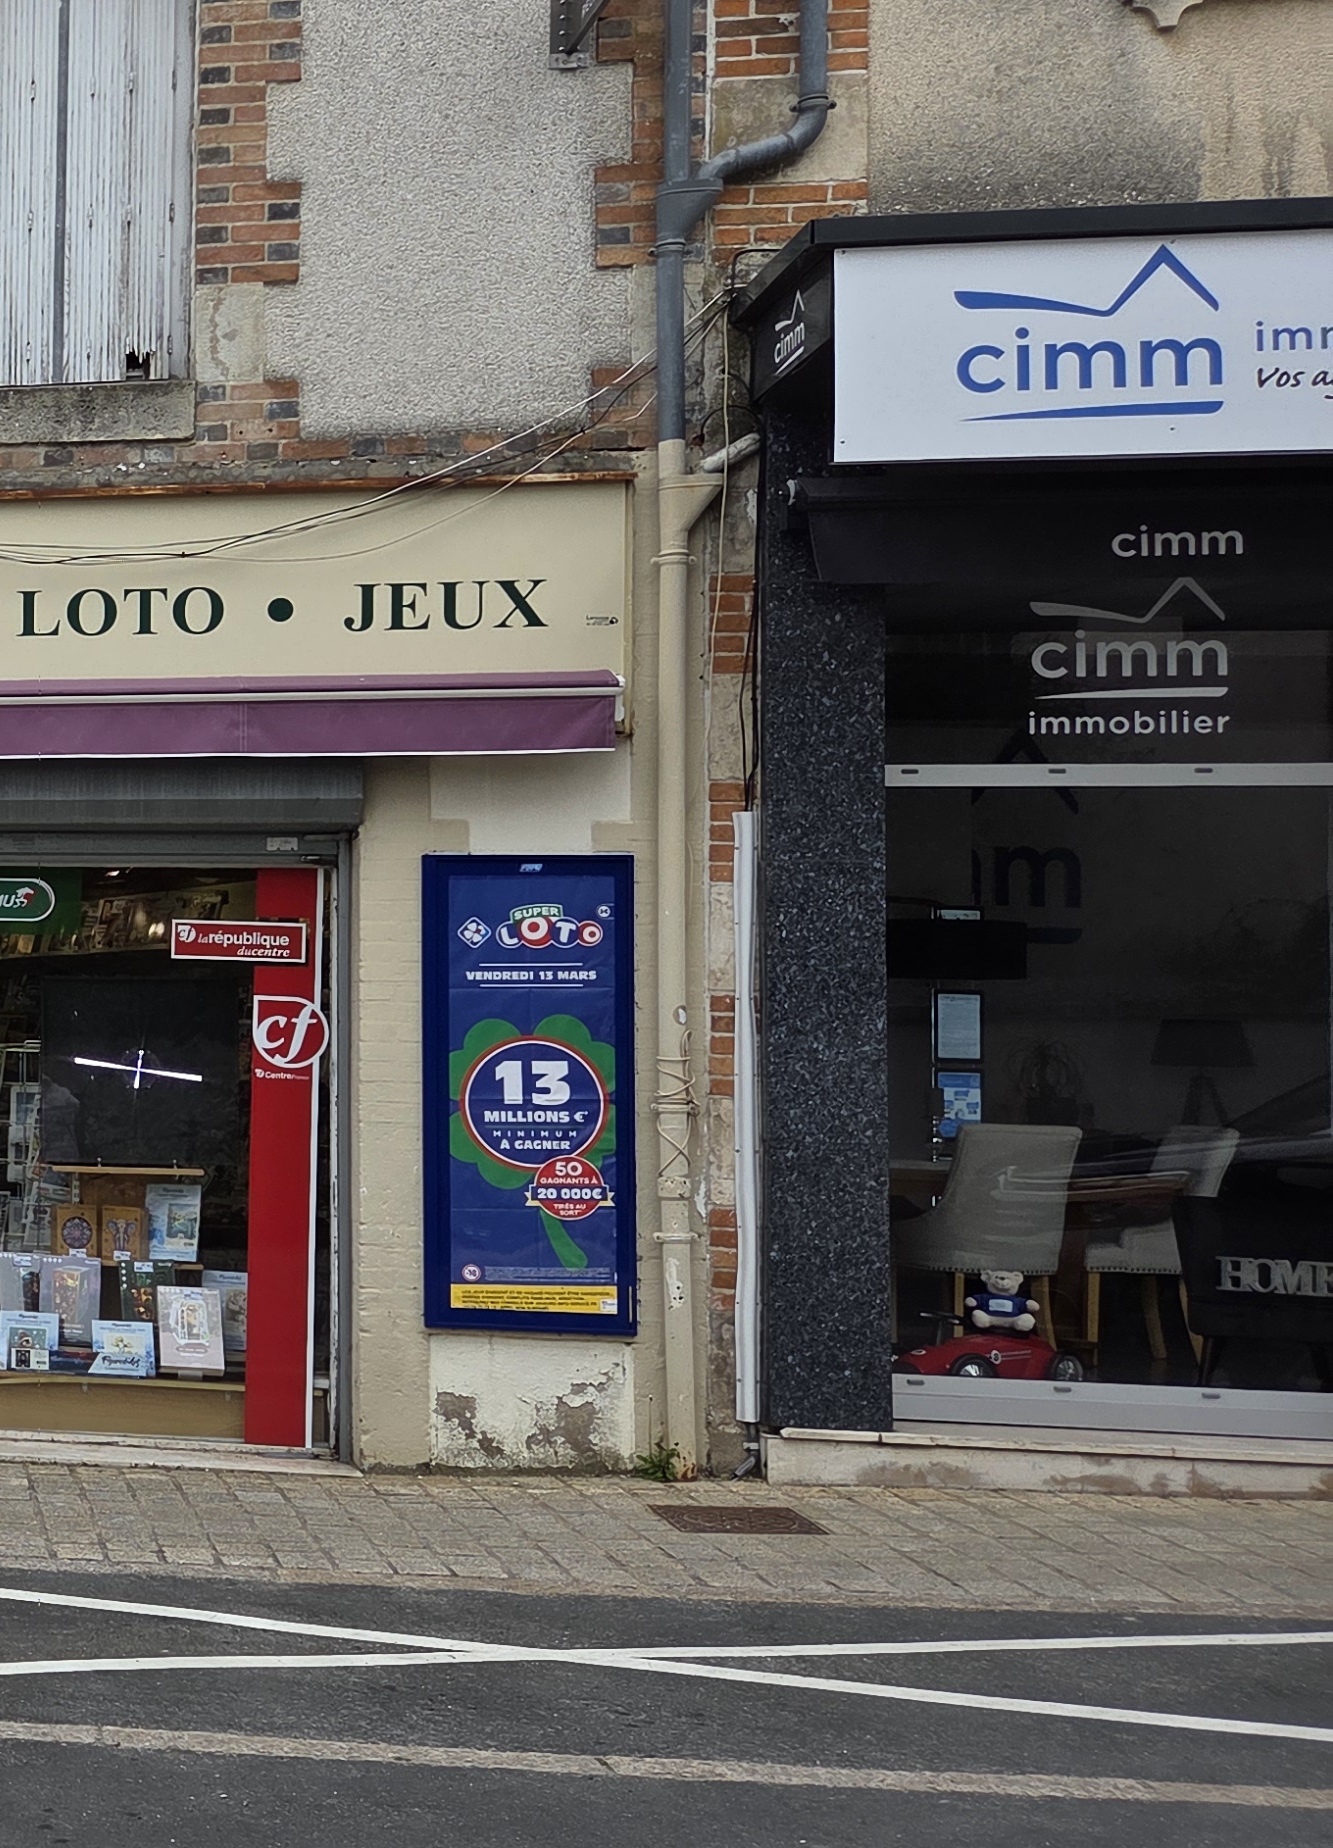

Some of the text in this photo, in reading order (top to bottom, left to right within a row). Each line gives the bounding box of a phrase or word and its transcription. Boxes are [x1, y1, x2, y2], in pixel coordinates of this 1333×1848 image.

[774, 322, 805, 364] cimm
[956, 327, 1223, 394] cimm
[1257, 367, 1333, 400] Vos a
[1111, 524, 1244, 557] cimm
[15, 578, 550, 638] LOTO JEUX
[1031, 629, 1229, 679] cimm
[1028, 709, 1231, 736] immobilier
[513, 906, 560, 921] SUPER
[500, 916, 600, 946] LOTO
[465, 970, 597, 981] VENDREDI 13 MARS
[494, 1060, 571, 1106] 13
[483, 1110, 571, 1123] MILLIONS
[492, 1129, 578, 1137] MINIMUM
[499, 1138, 571, 1150] À GAGNER
[539, 1177, 590, 1185] GAGNANTS
[554, 1161, 583, 1176] 50
[537, 1187, 603, 1200] 20 000€
